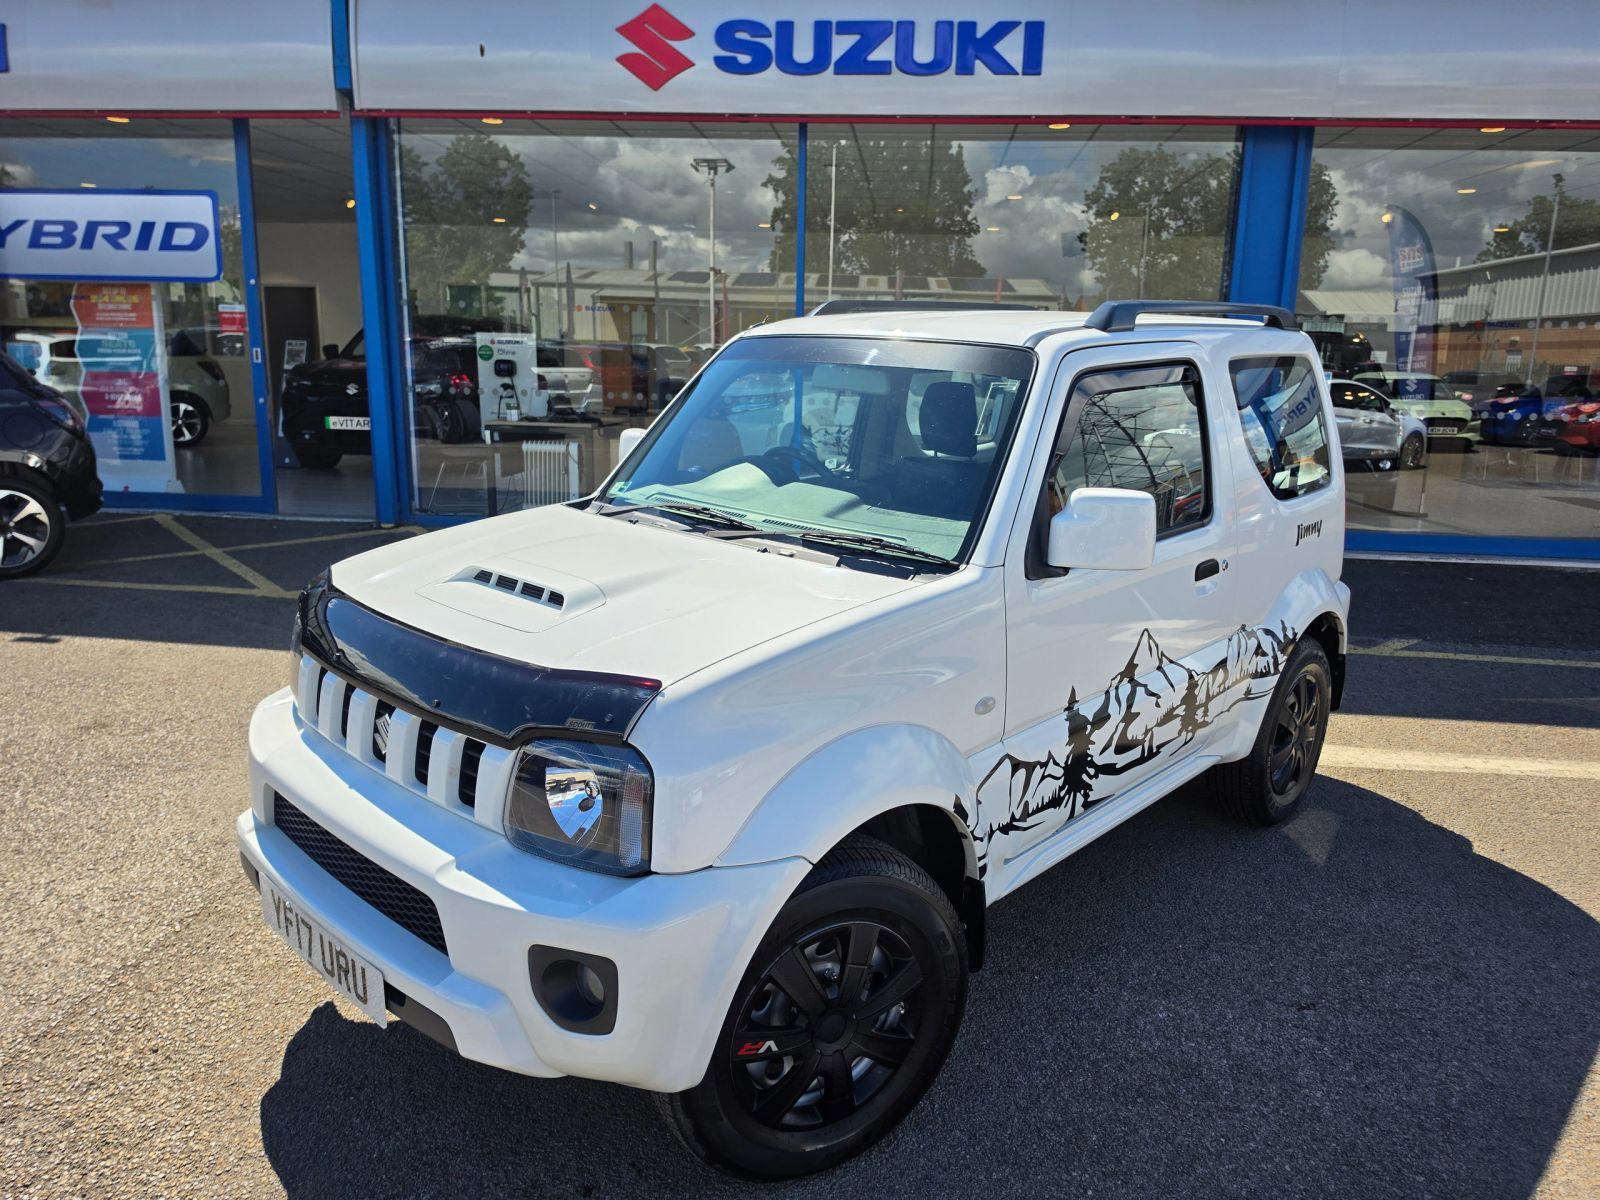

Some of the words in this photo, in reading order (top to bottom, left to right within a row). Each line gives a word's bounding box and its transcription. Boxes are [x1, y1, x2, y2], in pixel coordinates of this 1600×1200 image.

[713, 19, 1045, 76] SUZUKI
[1295, 519, 1322, 547] Jimny
[319, 932, 368, 1005] URU
